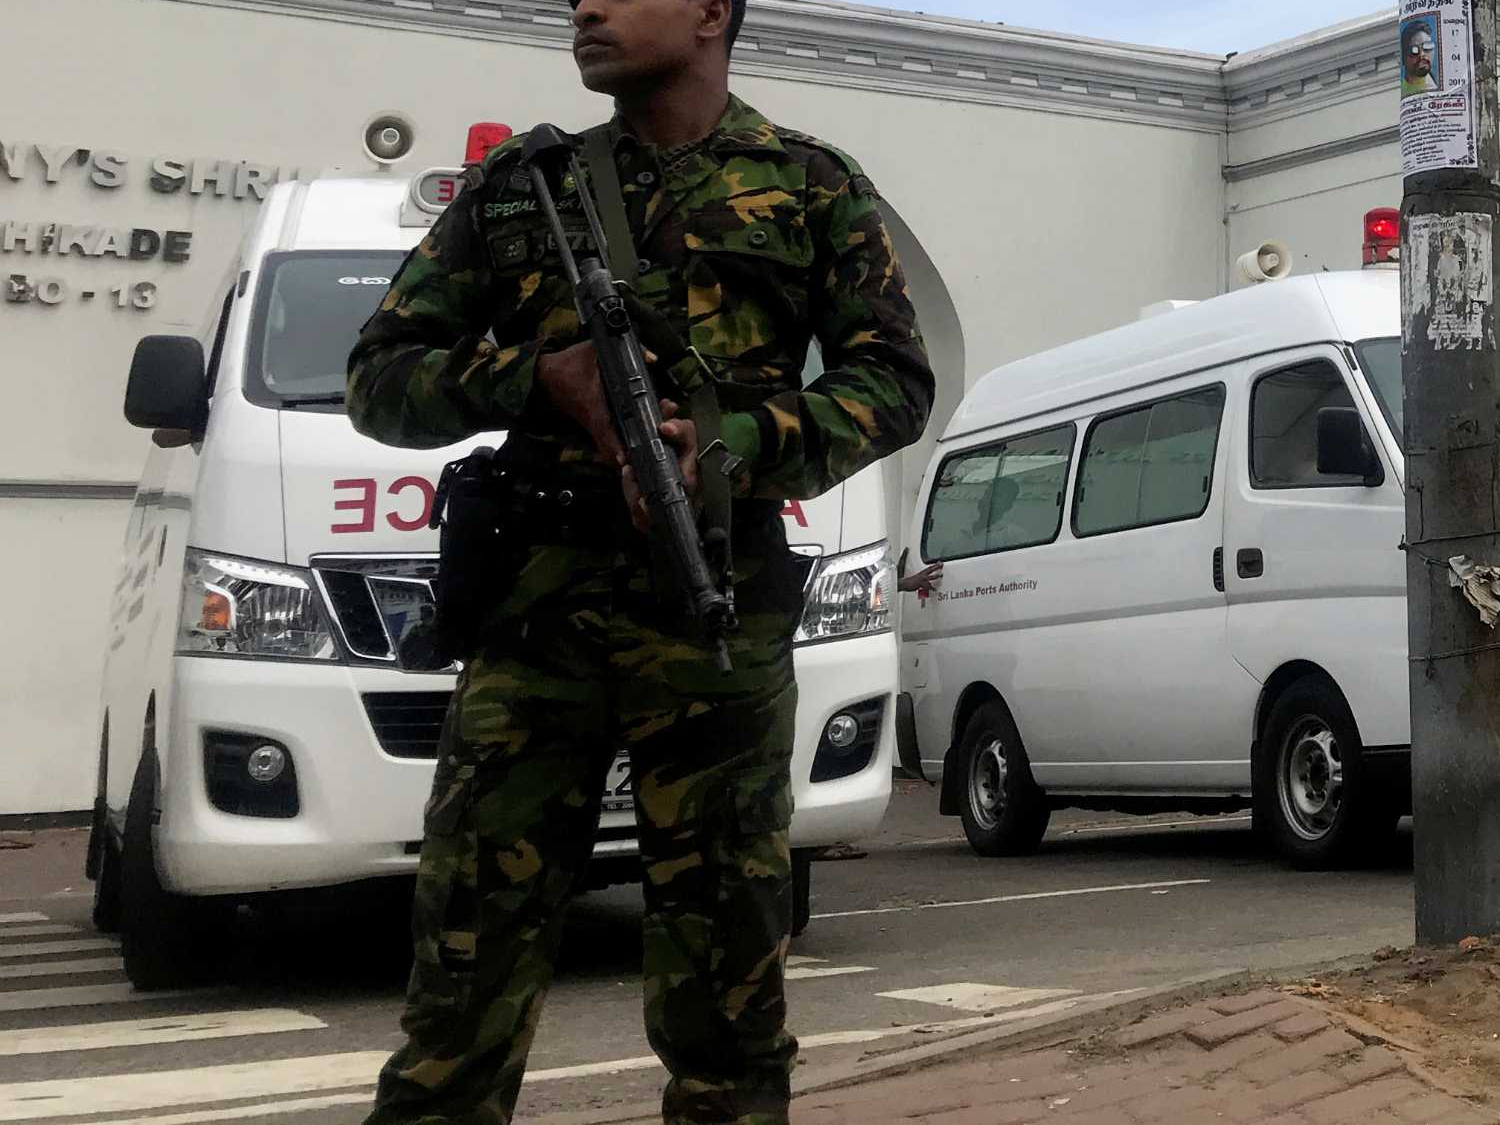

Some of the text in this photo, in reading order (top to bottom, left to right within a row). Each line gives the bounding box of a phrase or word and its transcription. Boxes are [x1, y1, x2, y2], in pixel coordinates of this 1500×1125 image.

[1449, 78, 1466, 86] 2019
[150, 156, 284, 201] SHR
[484, 199, 537, 218] SPECIAL
[111, 281, 157, 309] 13
[950, 588, 974, 600] Lanka
[975, 585, 997, 596] Ports
[998, 578, 1038, 594] Authority
